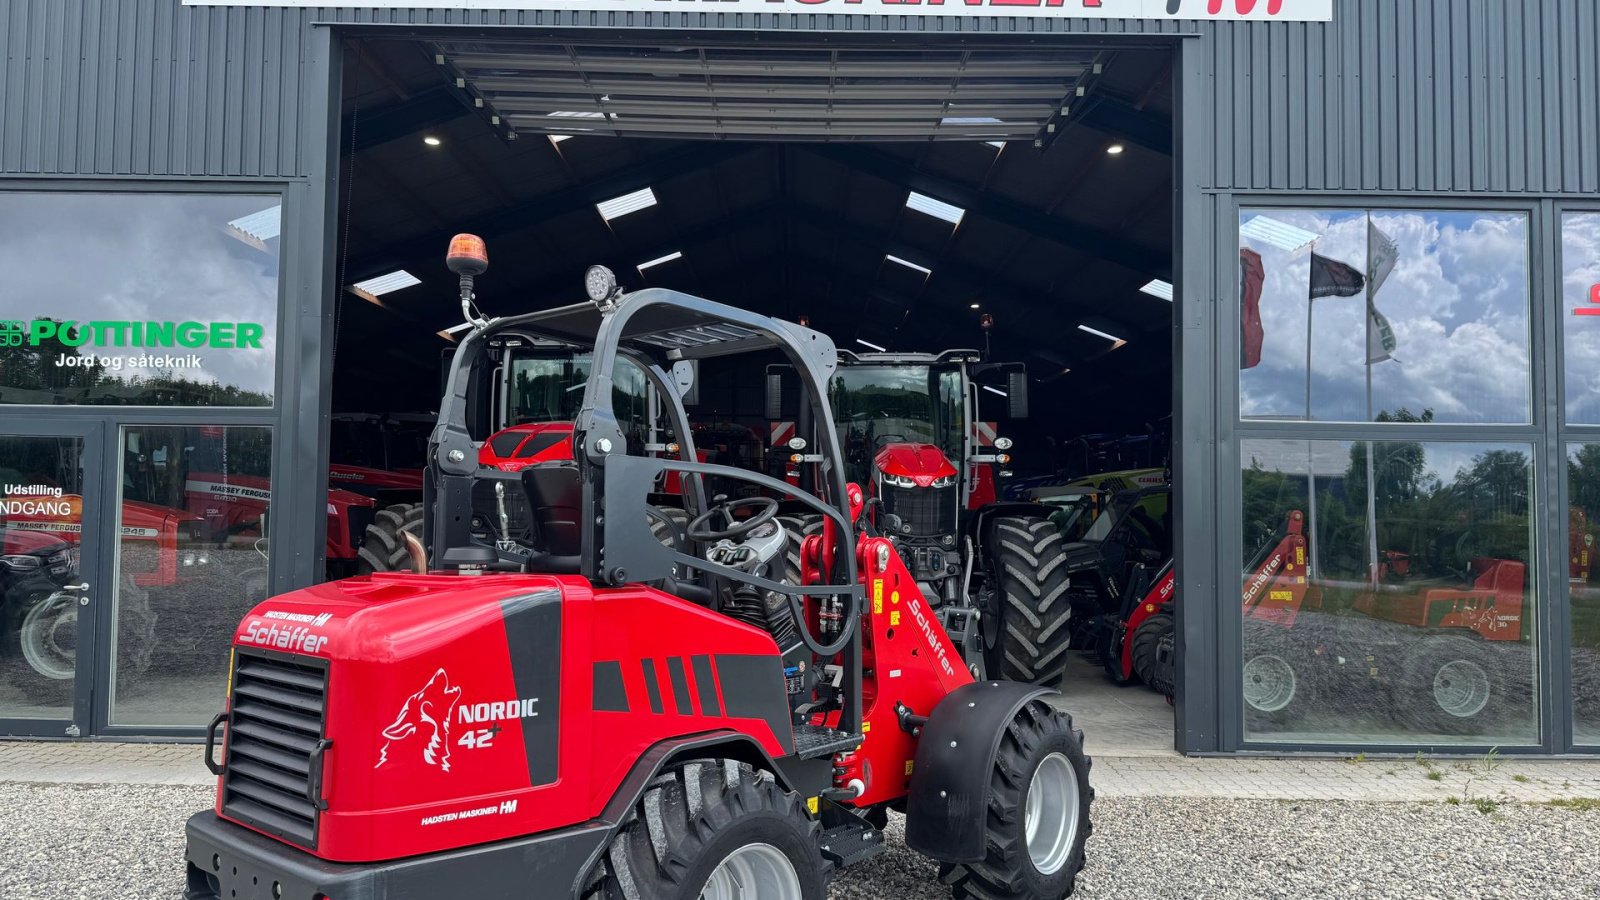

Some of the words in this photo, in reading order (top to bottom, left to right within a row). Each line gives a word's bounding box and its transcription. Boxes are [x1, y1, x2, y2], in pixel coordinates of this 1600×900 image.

[55, 353, 95, 368] Jord
[100, 357, 122, 369] og
[128, 353, 201, 369] såteknik
[4, 483, 63, 497] Udstilling
[210, 485, 240, 495] MASSEY
[16, 522, 48, 531] MASSEY
[1243, 554, 1281, 605] Schäffer
[239, 620, 328, 653] Schäffer
[906, 599, 954, 676] Schäffer
[458, 698, 539, 724] NORDIC
[421, 812, 458, 826] HADSTEN
[458, 806, 498, 820] MASKINER
[499, 799, 518, 815] HM
